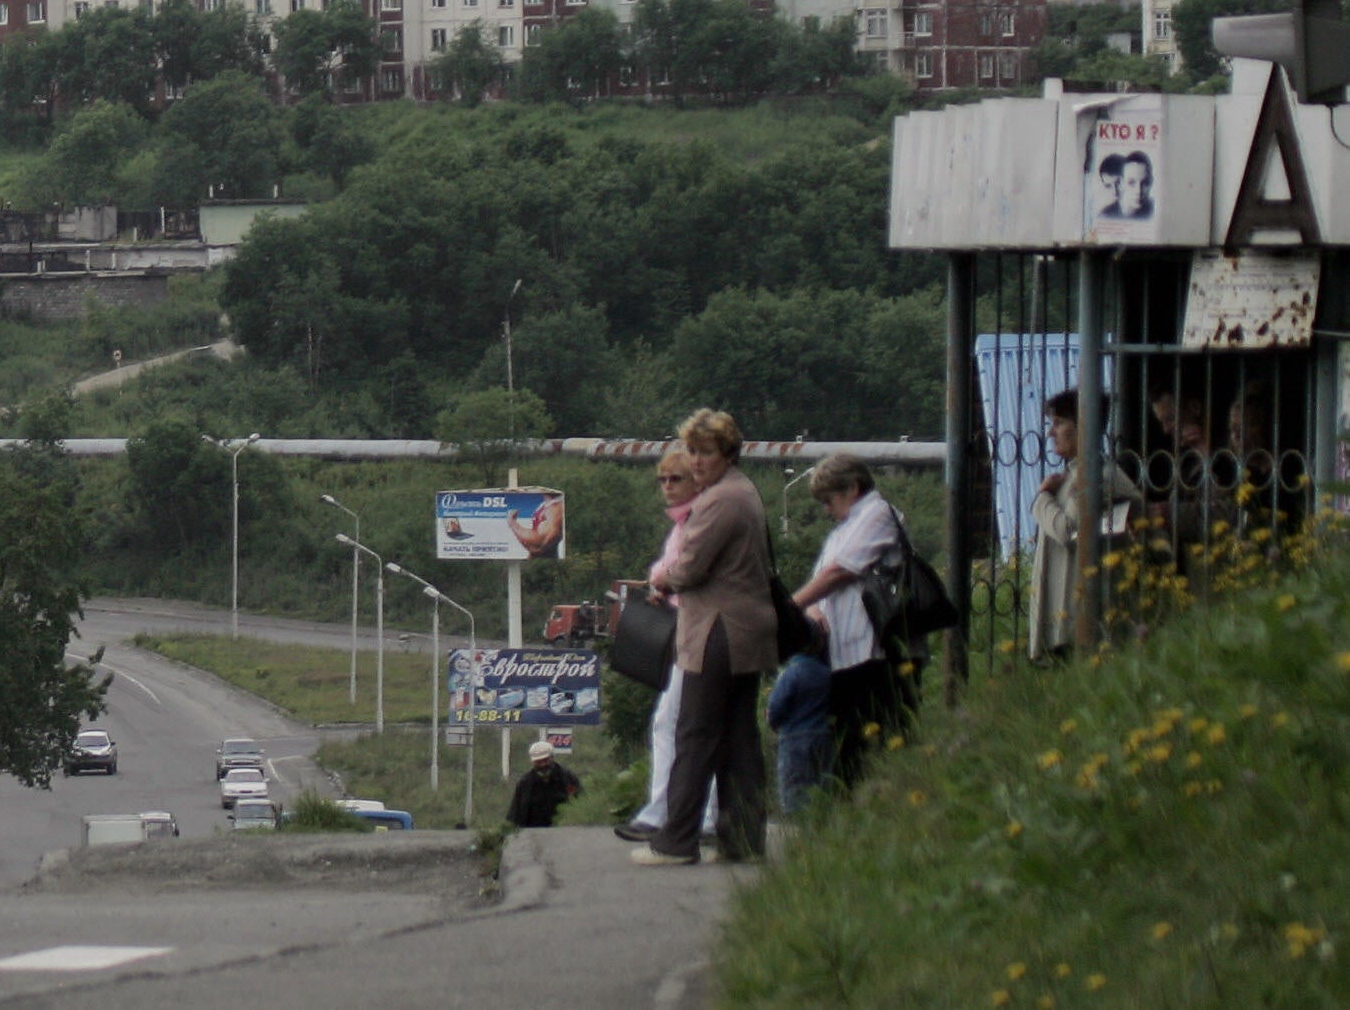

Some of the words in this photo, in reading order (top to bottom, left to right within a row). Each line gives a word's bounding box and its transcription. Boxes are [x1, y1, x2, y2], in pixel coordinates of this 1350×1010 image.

[1099, 123, 1131, 140] КТО
[1136, 124, 1146, 141] Я
[482, 496, 508, 508] DSL
[480, 651, 598, 685] Еврострой
